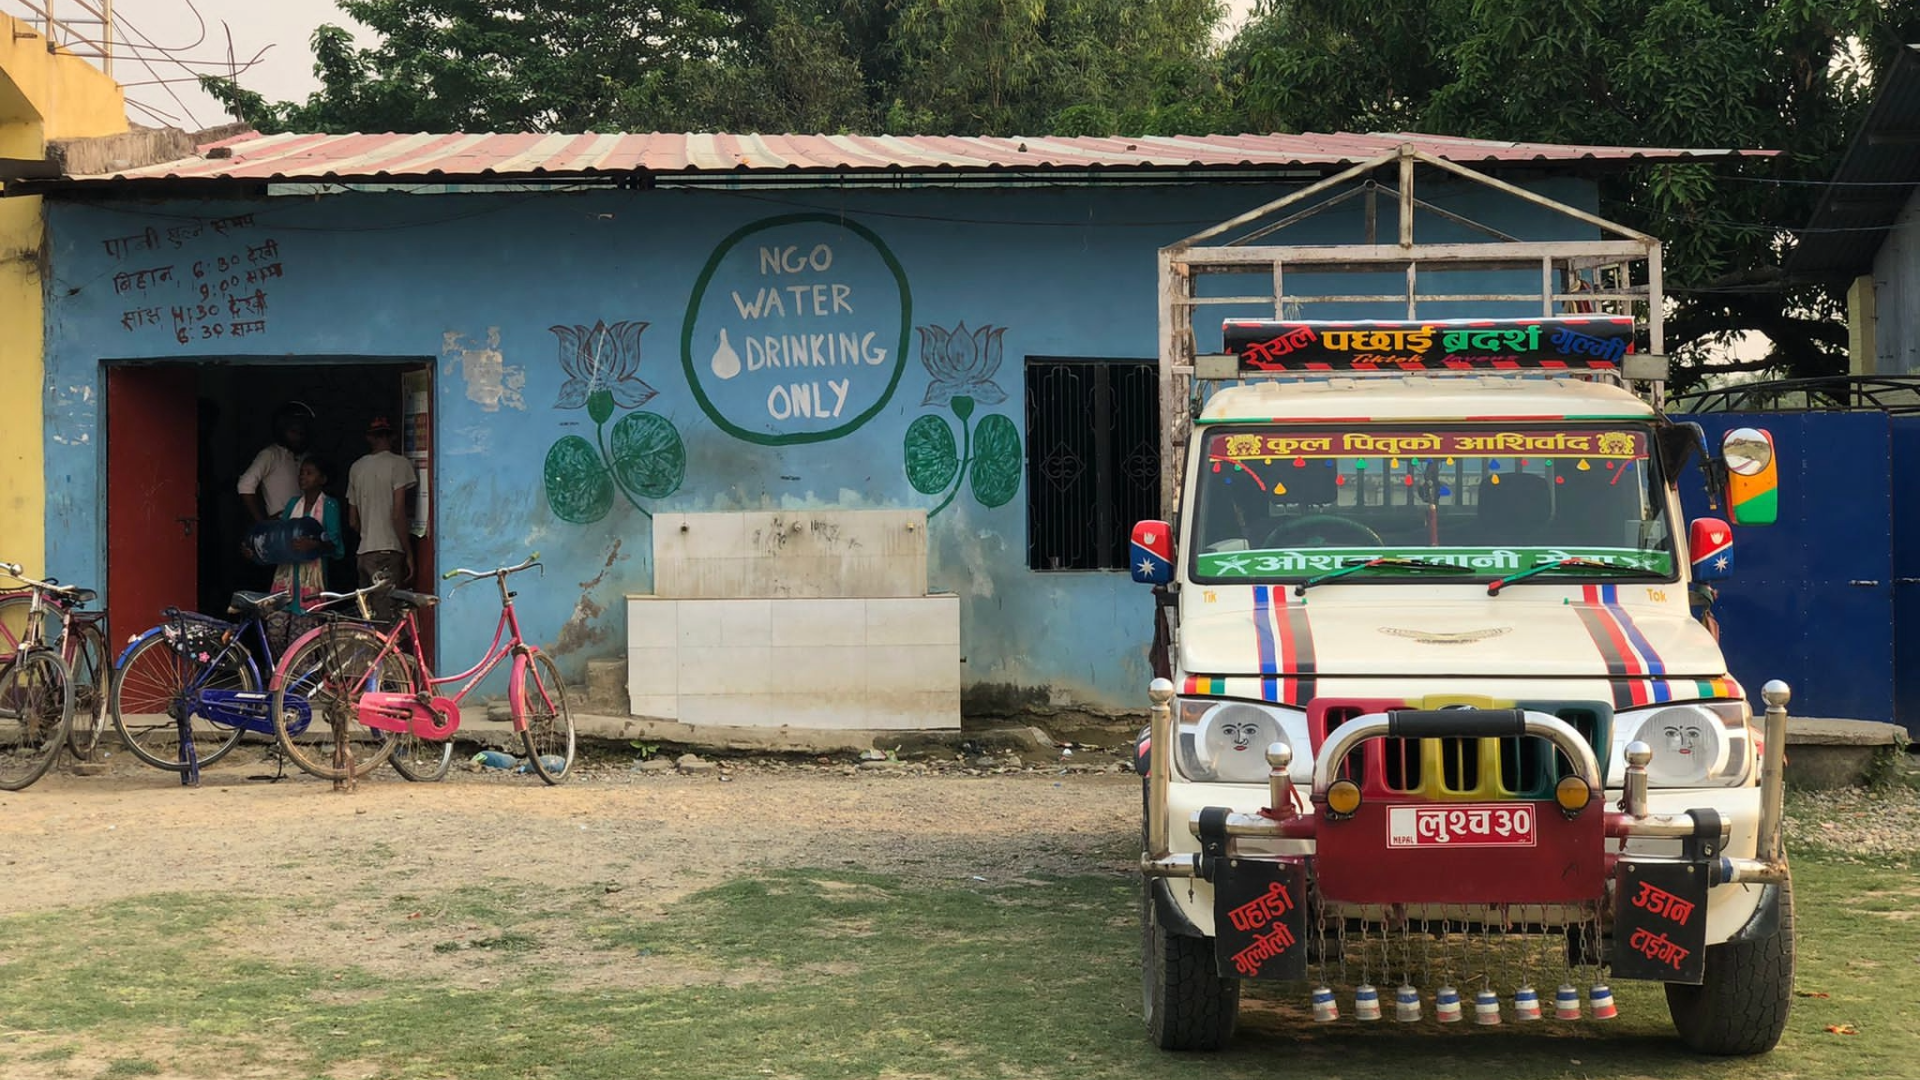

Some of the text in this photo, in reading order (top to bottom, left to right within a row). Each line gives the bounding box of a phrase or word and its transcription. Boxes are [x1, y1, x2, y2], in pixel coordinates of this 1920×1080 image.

[760, 244, 832, 275] NGO
[732, 284, 854, 320] WATER
[746, 331, 888, 372] DRINKING
[767, 378, 850, 420] ONLY
[1266, 437, 1333, 455] कुल
[1453, 433, 1592, 451] आशिर्वाद
[1202, 591, 1216, 603] Tik
[1646, 588, 1667, 603] Tok
[1393, 836, 1414, 844] NEPAL
[1228, 882, 1294, 931] पहाडी
[1631, 881, 1695, 926] उडान
[1630, 927, 1690, 970] टाईगर
